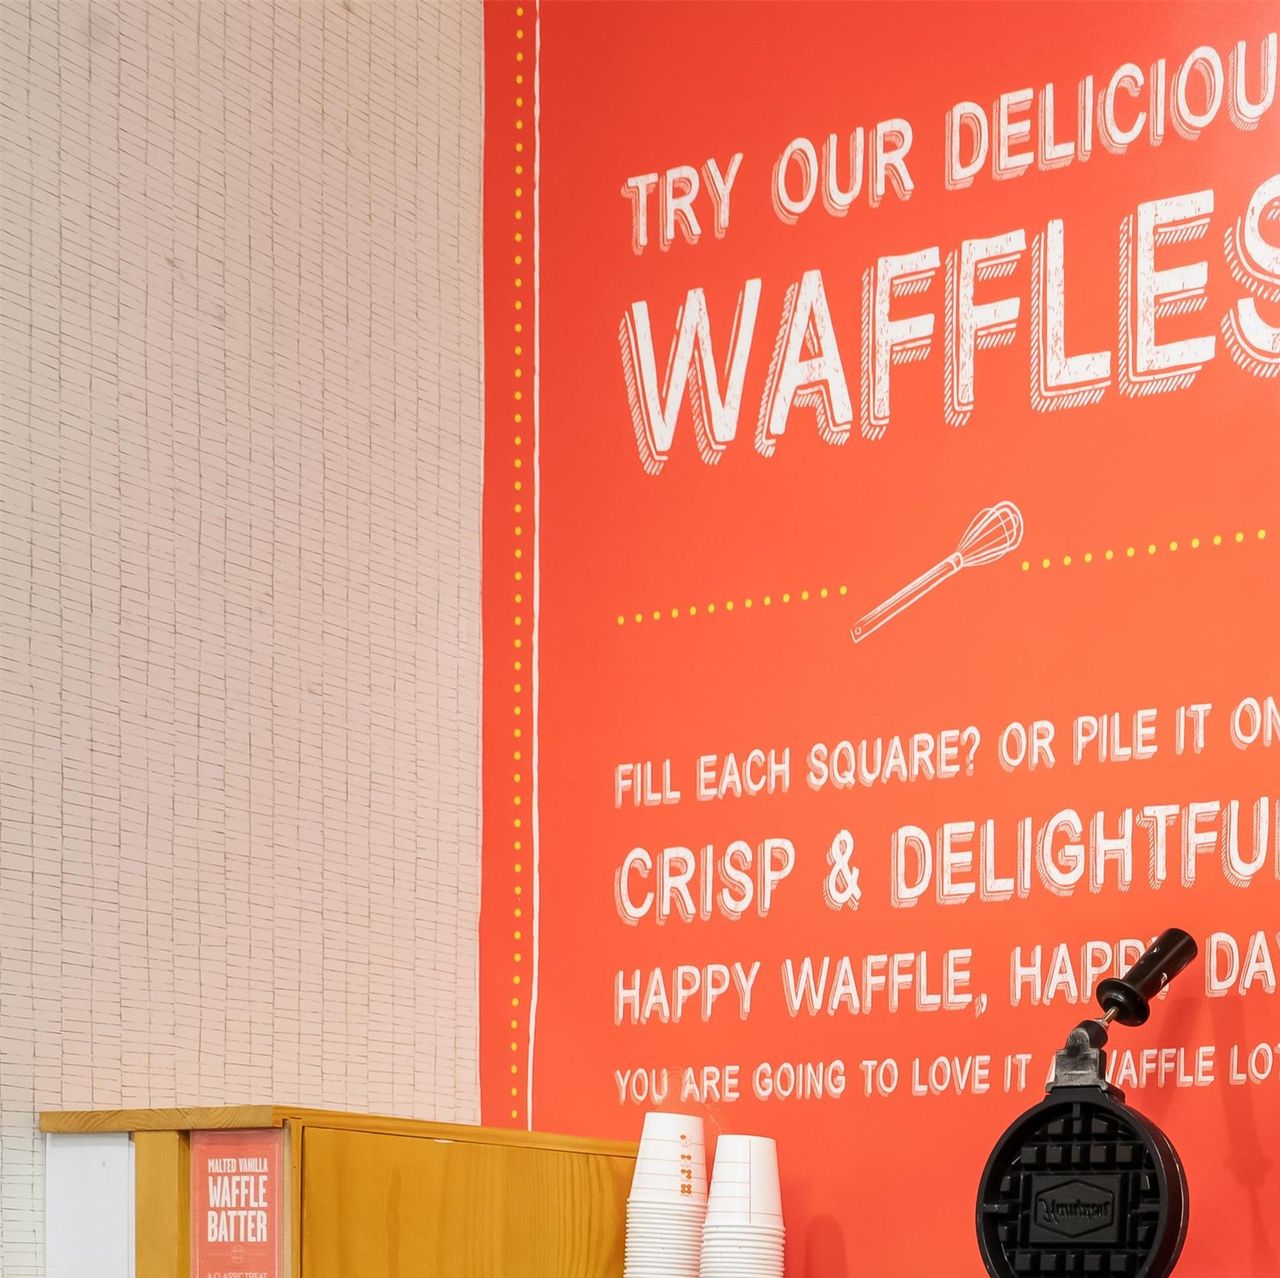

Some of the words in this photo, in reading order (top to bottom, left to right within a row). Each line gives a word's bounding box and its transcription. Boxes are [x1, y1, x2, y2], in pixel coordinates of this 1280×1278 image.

[622, 153, 743, 254] TRY
[771, 118, 915, 225] OUR
[614, 762, 681, 808] FILL
[695, 747, 790, 801] EACH
[805, 724, 981, 793] SQUARE?
[997, 719, 1055, 772] OR
[1072, 707, 1158, 765] PILE
[1175, 702, 1212, 754] IT
[614, 836, 796, 927] CRISP
[822, 828, 862, 912] &
[614, 959, 761, 1026] HAPPY
[785, 947, 989, 1020] WAFFLE,
[1010, 936, 1170, 1008] HAPP
[614, 1065, 667, 1105] YOU
[680, 1063, 740, 1104] ARE
[751, 1059, 846, 1103] GOING
[860, 1058, 898, 1099] TO
[912, 1053, 991, 1096] LOVE
[1003, 1052, 1032, 1094] IT
[207, 1158, 237, 1173] MALTED
[239, 1157, 268, 1172] VANILLA
[208, 1175, 268, 1208] WAFFLE
[207, 1210, 267, 1242] BATTER
